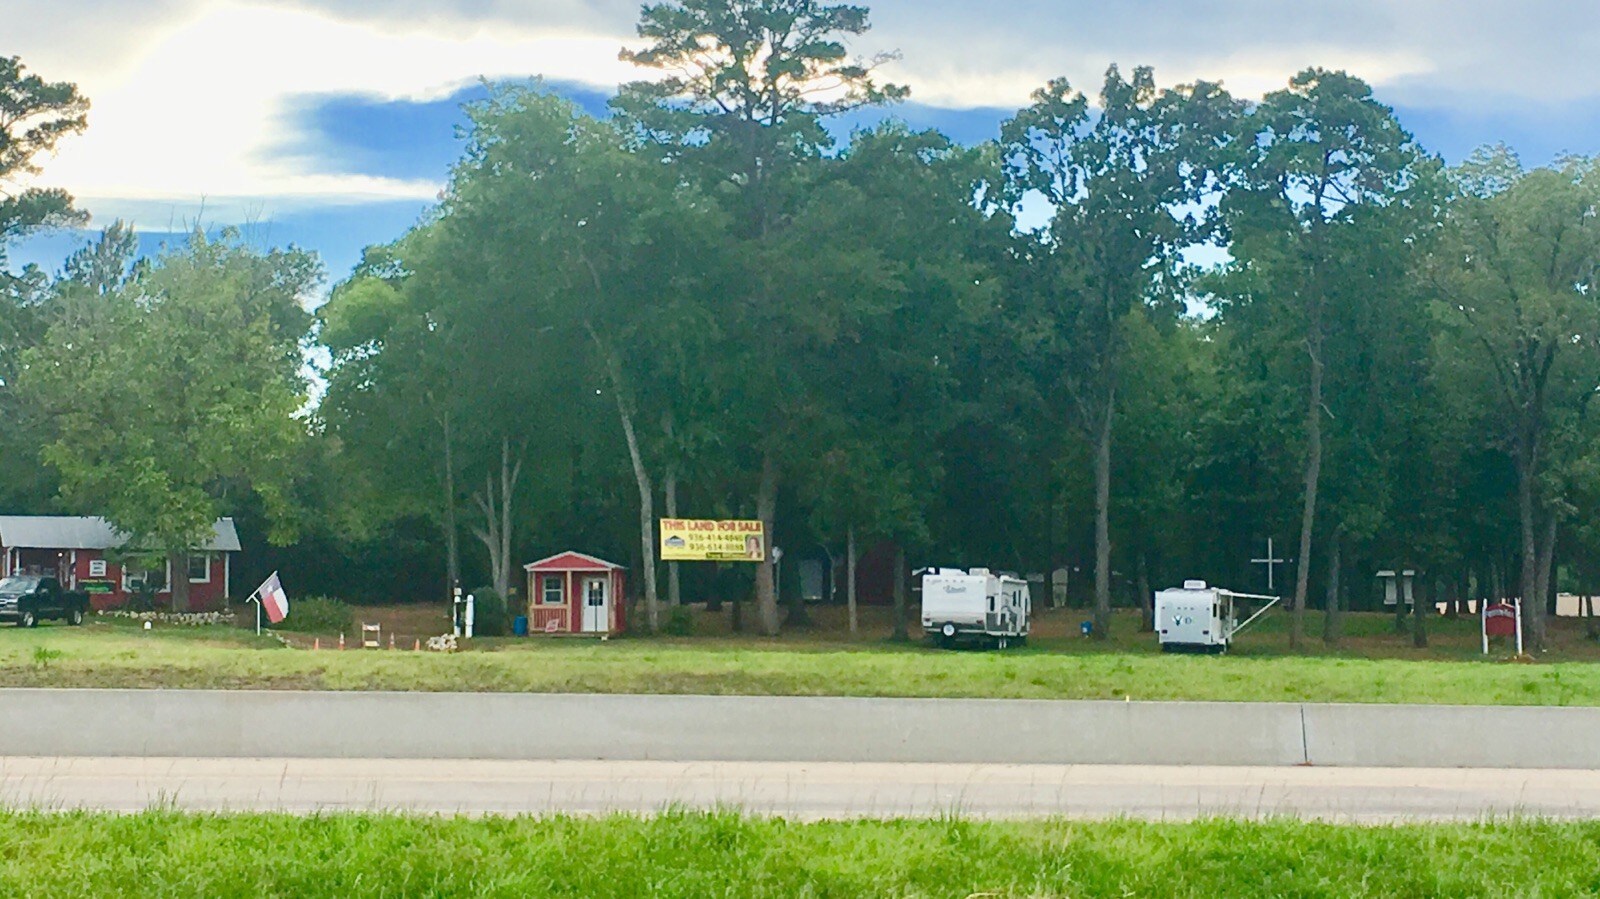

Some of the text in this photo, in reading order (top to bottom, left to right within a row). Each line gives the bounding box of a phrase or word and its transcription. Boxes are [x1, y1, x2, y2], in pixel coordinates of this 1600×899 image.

[663, 520, 761, 531] THIS LAND FOR SALE
